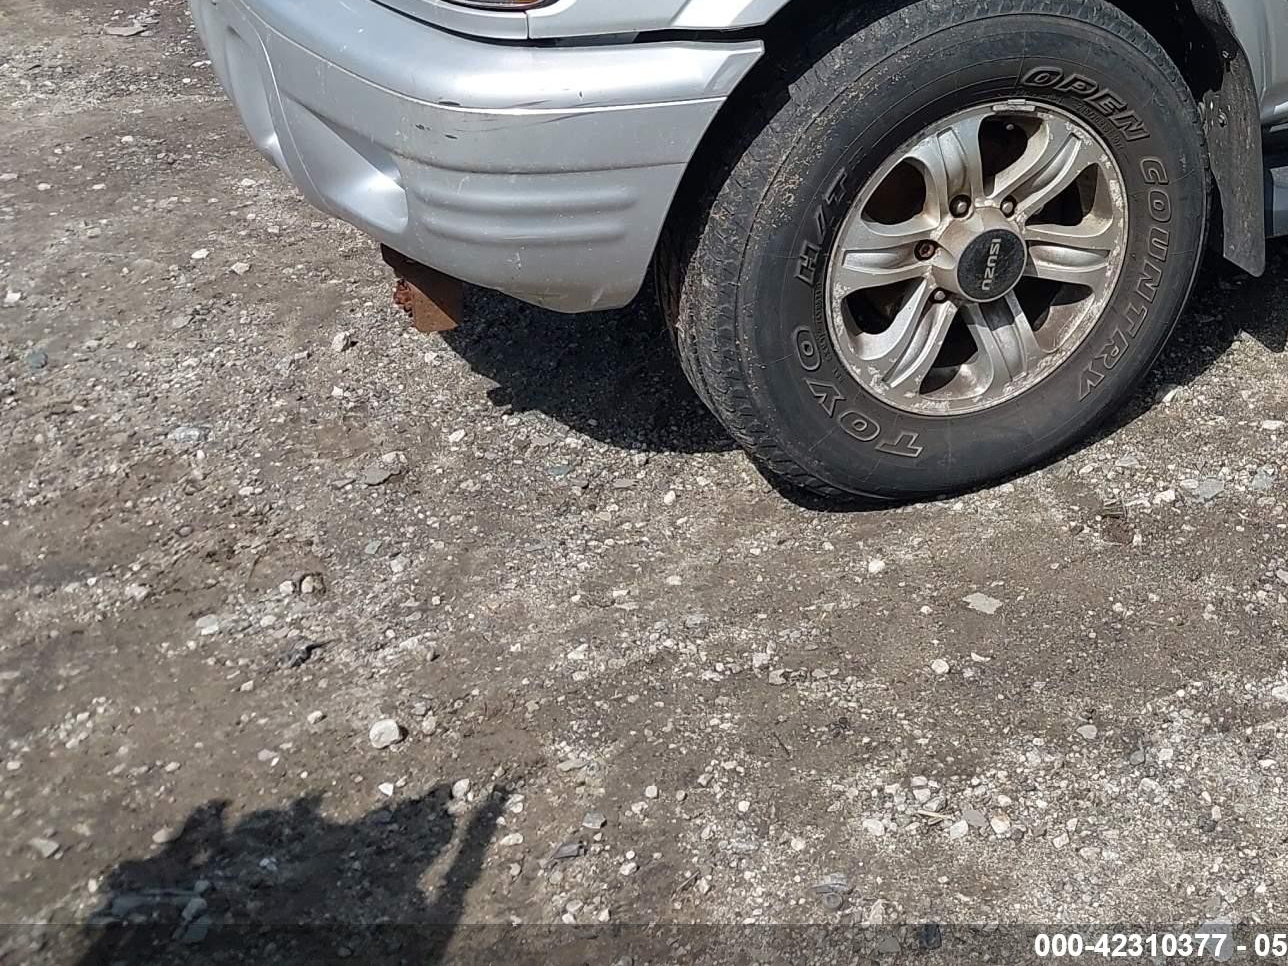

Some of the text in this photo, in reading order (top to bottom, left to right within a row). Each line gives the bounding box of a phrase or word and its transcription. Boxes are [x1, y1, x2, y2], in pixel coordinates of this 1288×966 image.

[1021, 66, 1151, 142] OPEN
[981, 238, 1002, 291] ISUZU
[1078, 155, 1173, 403] COUNTRY
[792, 325, 925, 458] TOYO
